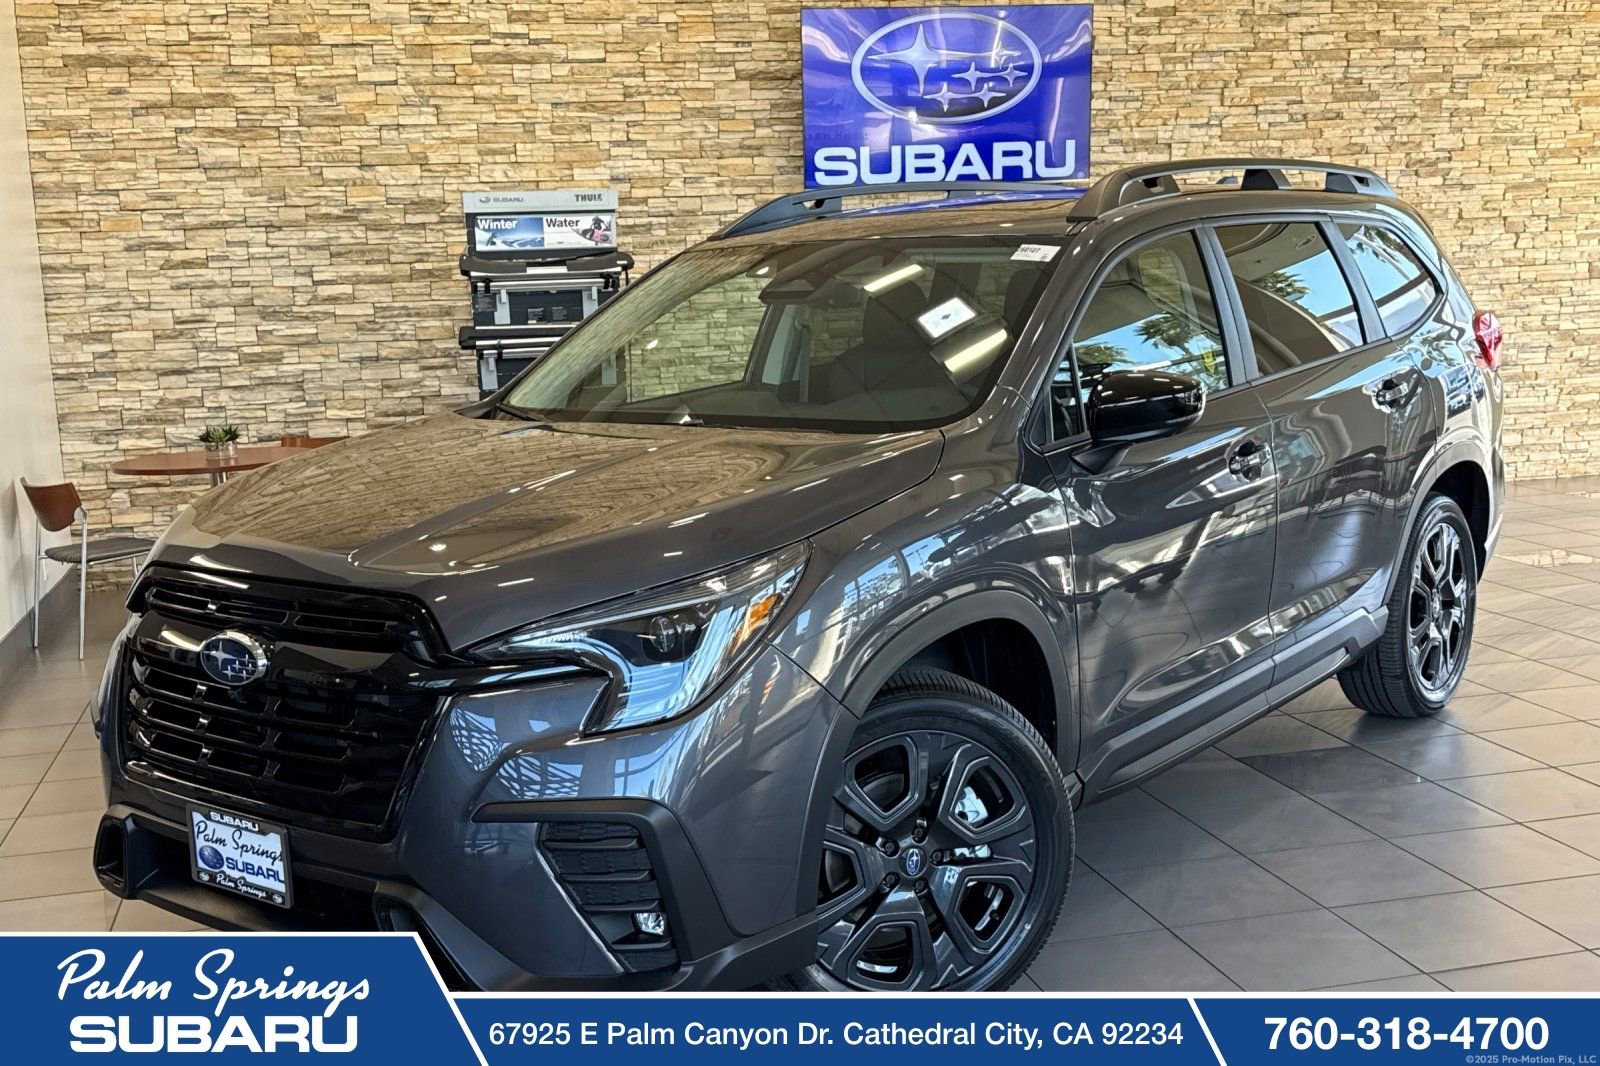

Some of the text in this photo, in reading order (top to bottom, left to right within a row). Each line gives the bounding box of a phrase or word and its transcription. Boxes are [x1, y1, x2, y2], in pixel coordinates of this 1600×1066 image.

[814, 139, 1076, 186] SUBARU
[575, 194, 603, 202] THULE
[478, 218, 518, 230] Winter
[546, 218, 580, 228] Water
[210, 812, 259, 831] SUBARU
[195, 820, 227, 847] Palm
[216, 873, 267, 899] Palm Springs
